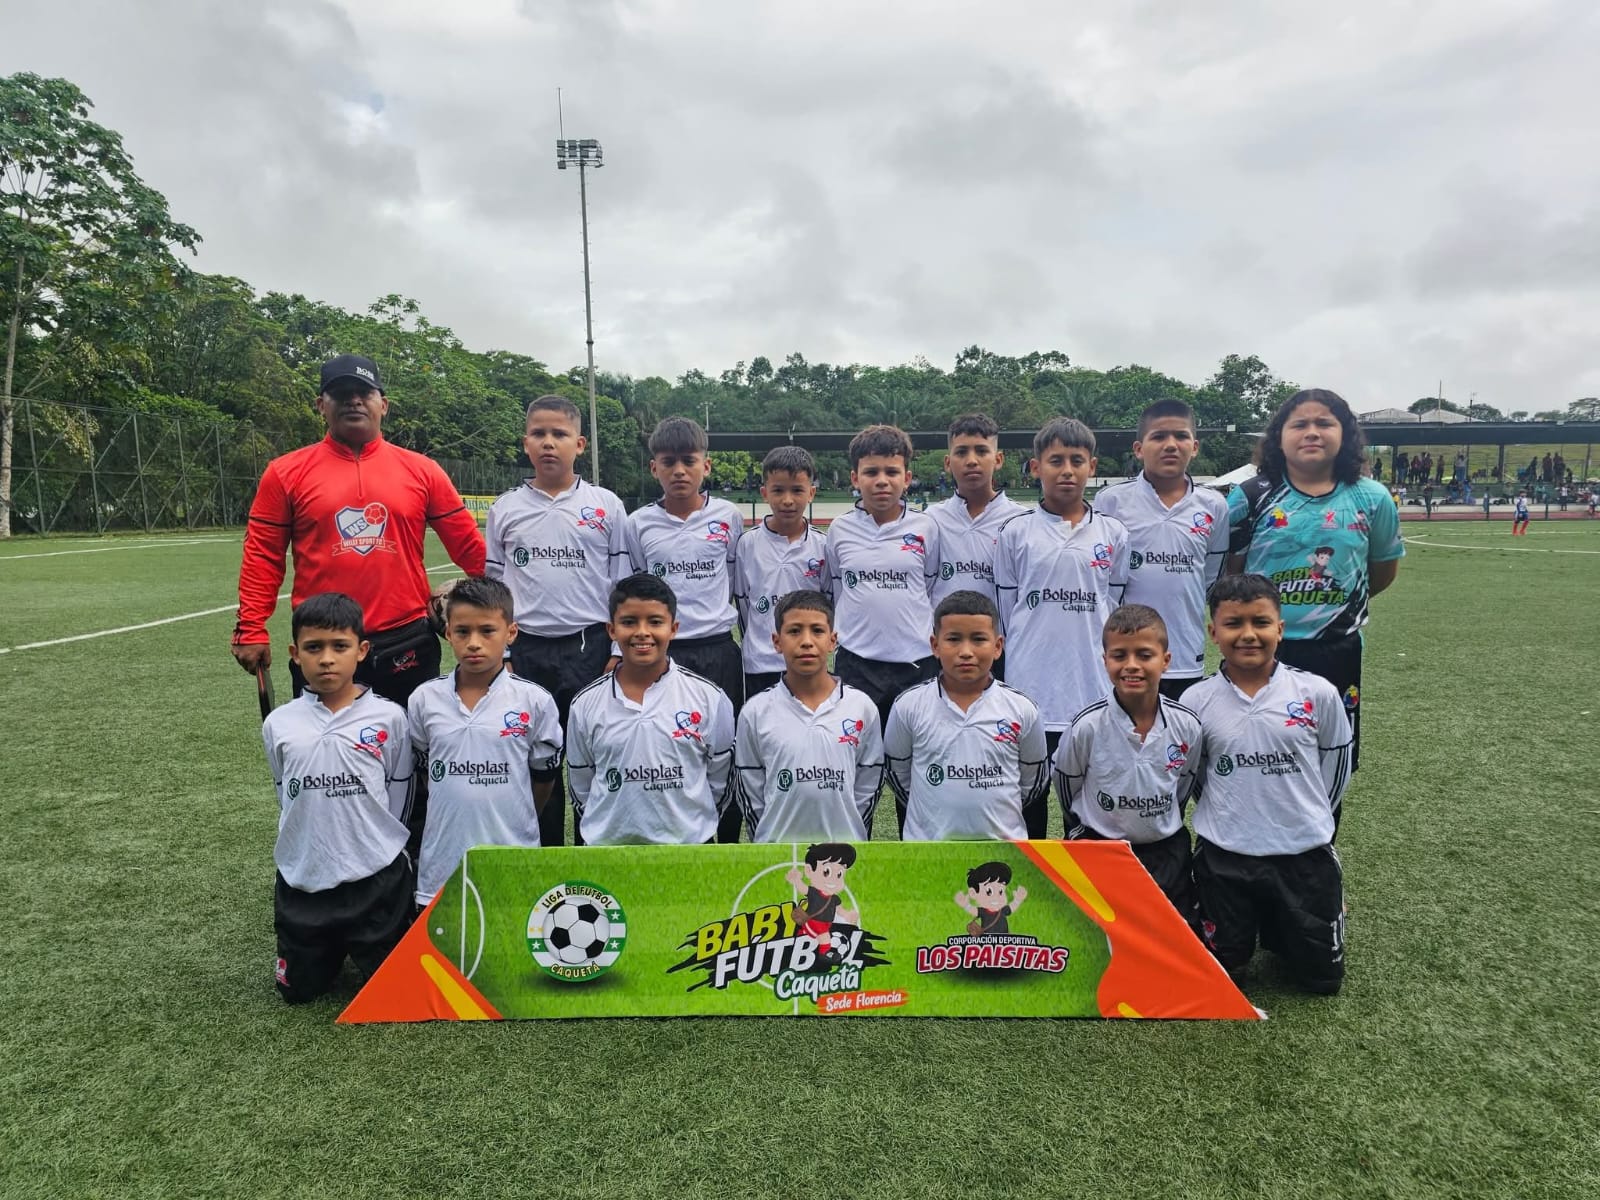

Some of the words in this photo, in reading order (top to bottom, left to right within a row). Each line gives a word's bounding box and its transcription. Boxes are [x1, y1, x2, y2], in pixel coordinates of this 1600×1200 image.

[667, 559, 715, 573] Bolsplast
[859, 568, 909, 583] Bolsplast
[1042, 587, 1097, 604] Bolsplast
[1280, 590, 1345, 605] AQUETA
[448, 759, 510, 778] Bolsplast
[947, 764, 1002, 780] Bolsplast
[302, 771, 363, 790] Bolsplas
[541, 890, 564, 909] LIGA
[565, 886, 577, 896] DE
[580, 886, 613, 909] FUTBOL
[697, 899, 808, 961] BABY
[999, 936, 1037, 946] DEPORTIVA
[917, 945, 962, 973] LOS
[963, 944, 1069, 973] PAISITAS
[776, 965, 860, 1001] Caquetá
[826, 994, 852, 1012] Sede
[855, 991, 902, 1009] Florencia
